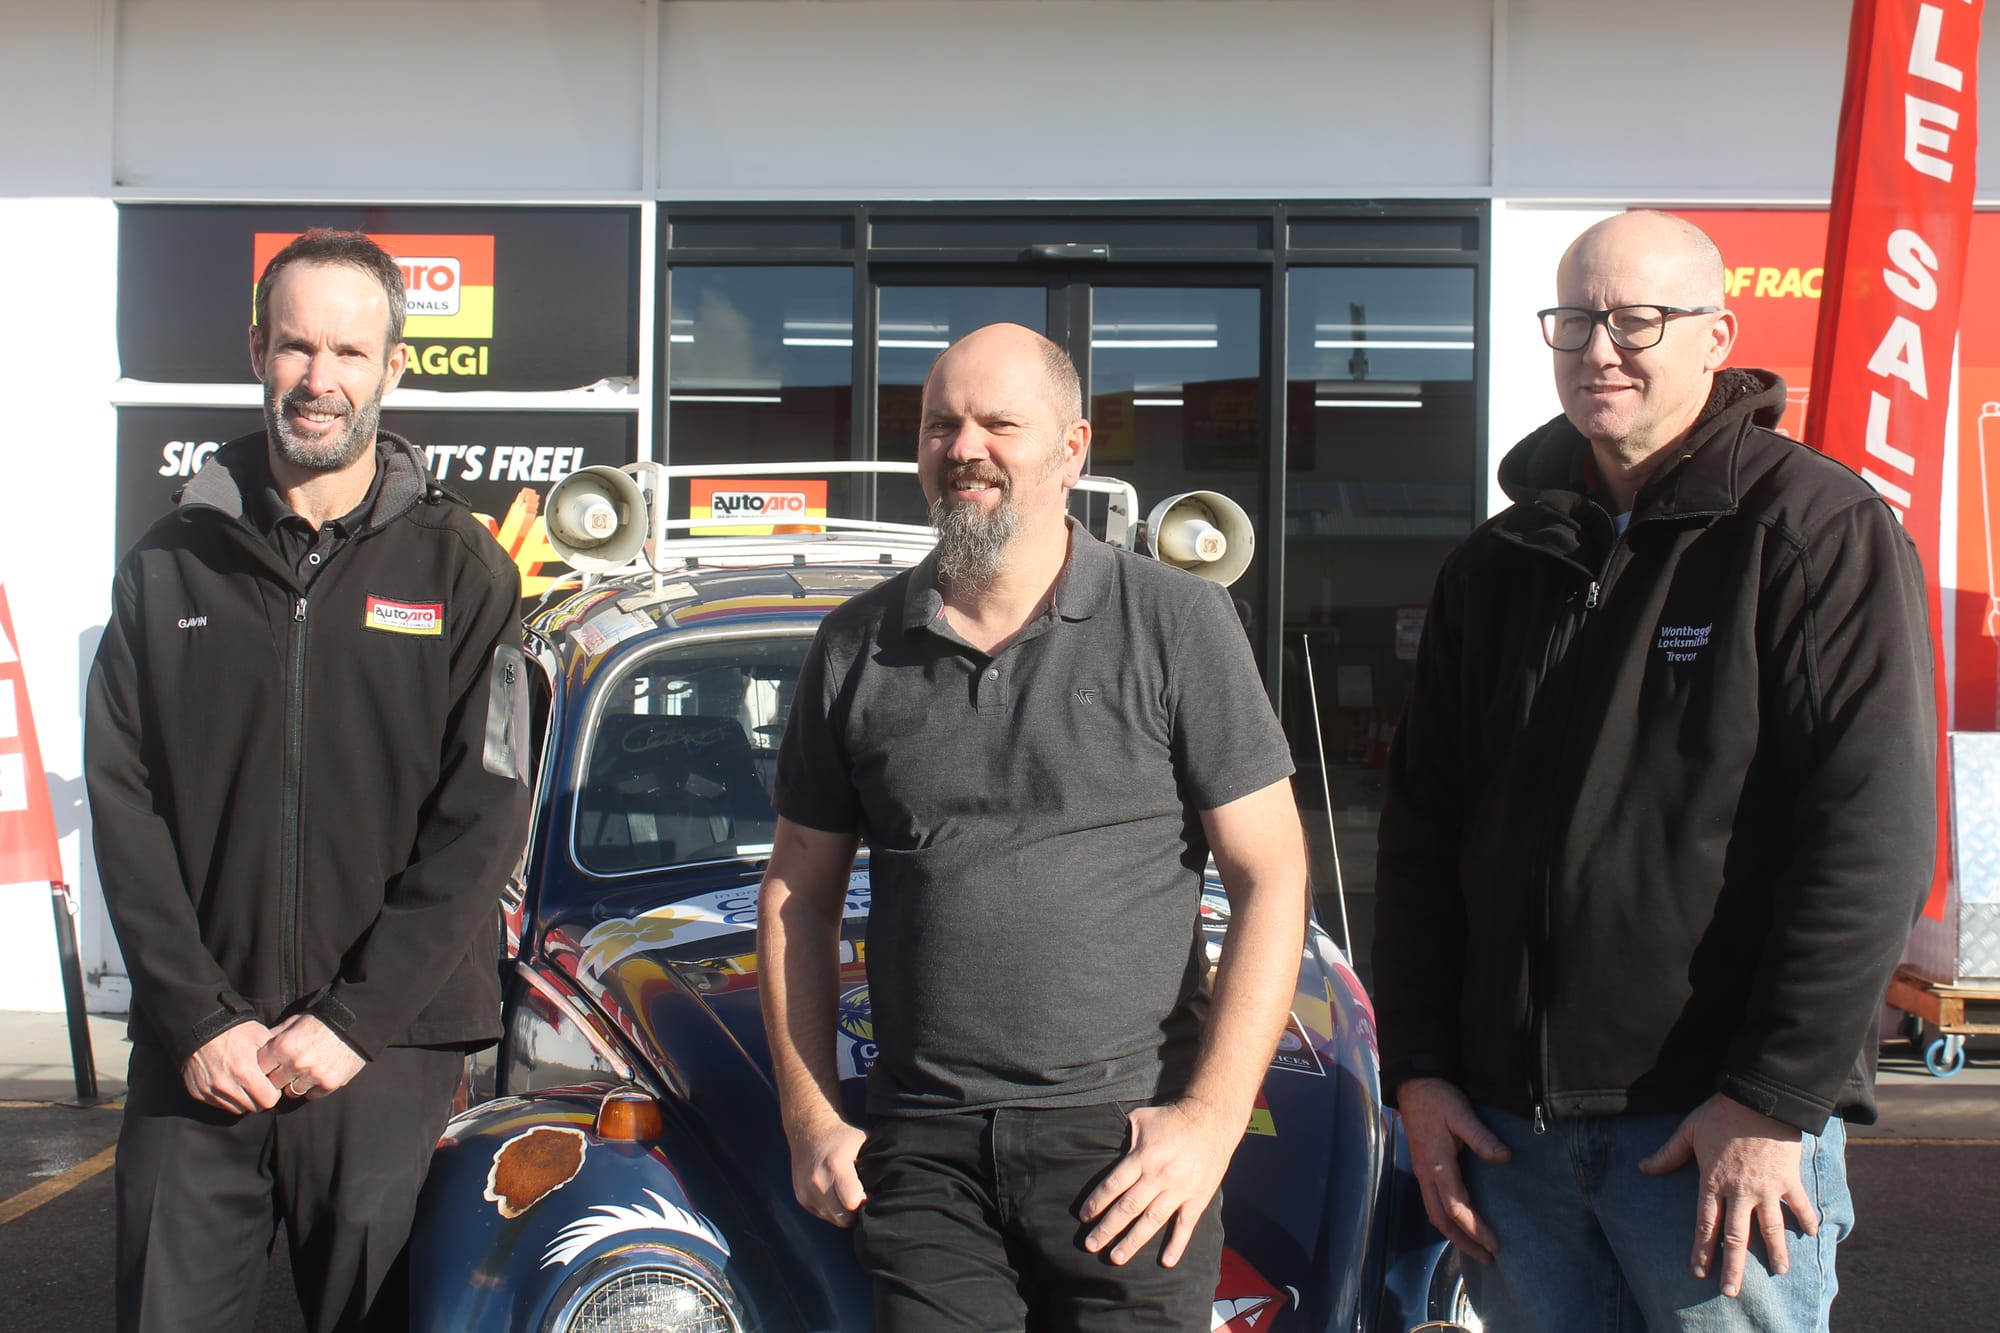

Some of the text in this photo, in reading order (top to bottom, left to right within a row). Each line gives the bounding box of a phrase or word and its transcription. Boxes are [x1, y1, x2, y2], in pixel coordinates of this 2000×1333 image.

[1903, 0, 1973, 183] LE
[406, 301, 449, 310] ONALS
[405, 345, 489, 375] AGGI
[424, 445, 487, 481] IT'S
[489, 446, 585, 482] FREE!
[178, 615, 207, 629] GAVIN
[1657, 635, 1709, 649] Locksmiths
[1665, 651, 1698, 662] Trevor
